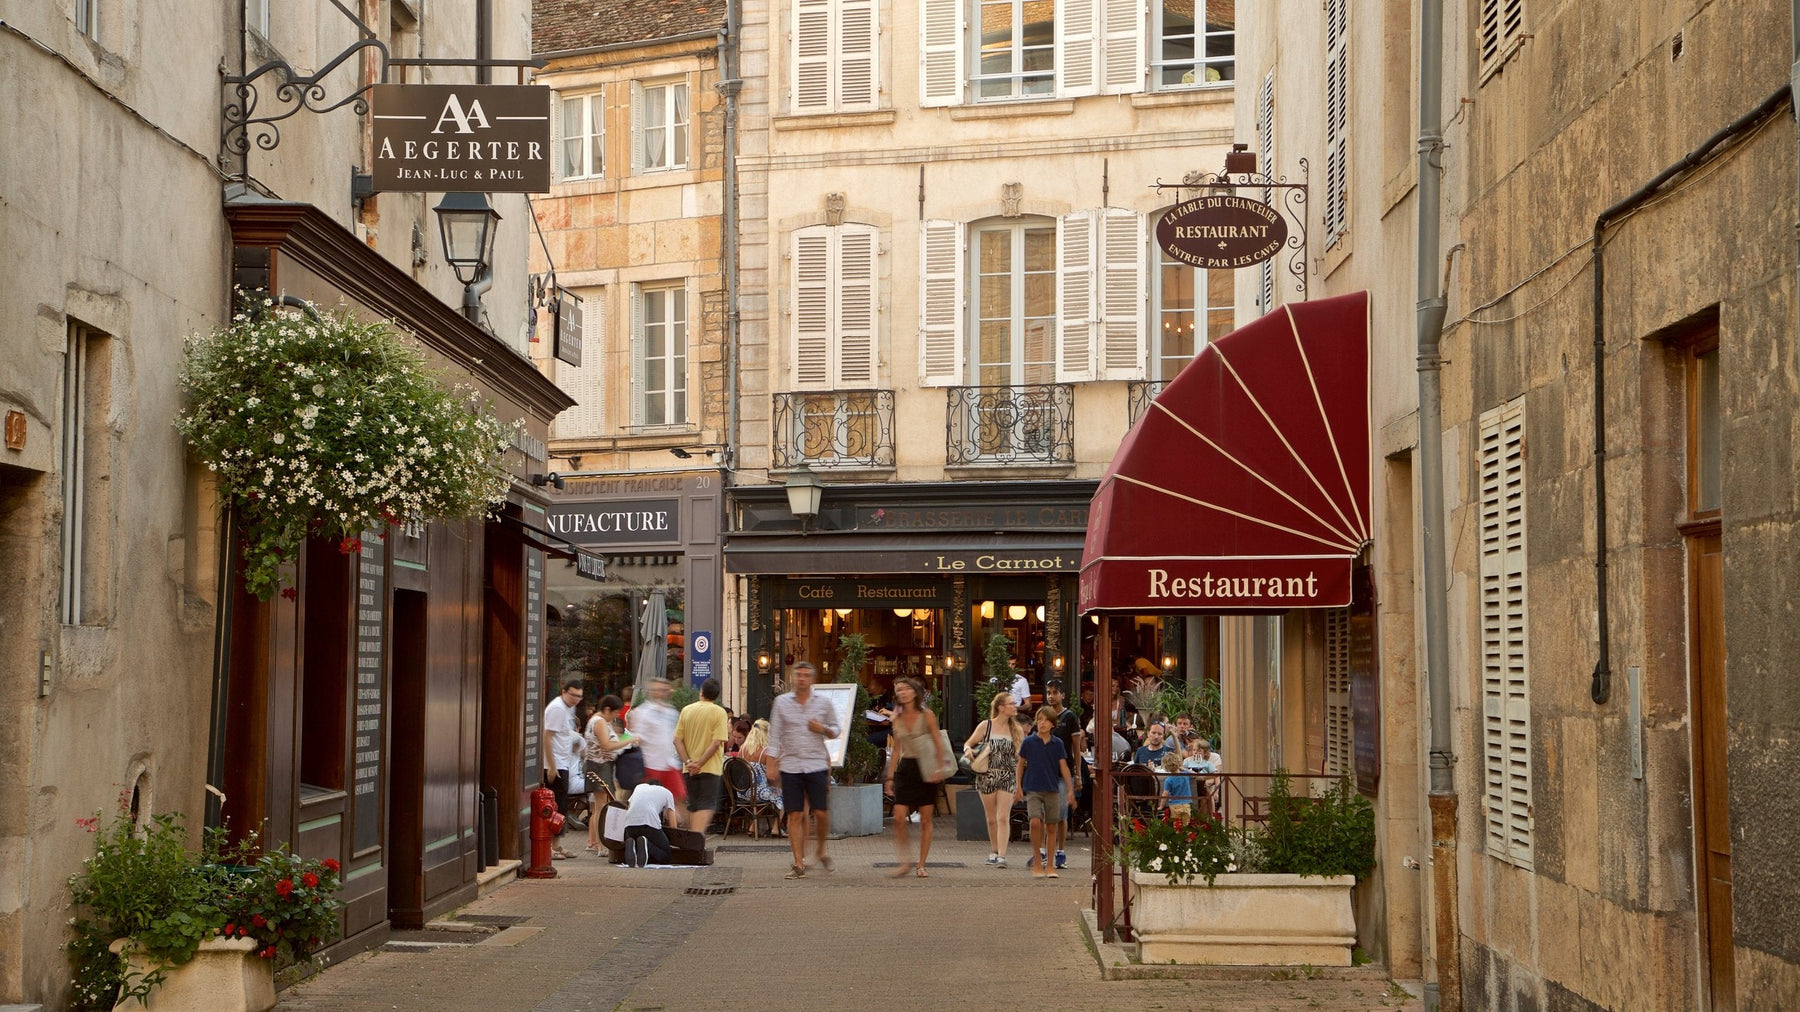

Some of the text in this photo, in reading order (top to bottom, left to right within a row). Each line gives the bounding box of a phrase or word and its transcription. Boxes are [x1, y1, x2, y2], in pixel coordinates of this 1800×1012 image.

[431, 94, 491, 134] AA
[378, 137, 543, 160] AEGERTER
[397, 168, 524, 179] JEAN-LUC & PAUL
[1165, 197, 1278, 225] LA TABLE DU CHANCELIER
[1175, 225, 1268, 239] RESTAURANT
[1168, 239, 1280, 267] ENTREE PAR LES CAVES
[696, 476, 710, 489] 20
[885, 508, 995, 527] BRASSERIE
[1004, 509, 1028, 526] LE
[937, 555, 1063, 570] Le Carnot
[799, 585, 937, 598] Café Restaurant
[1148, 569, 1318, 598] Restaurant
